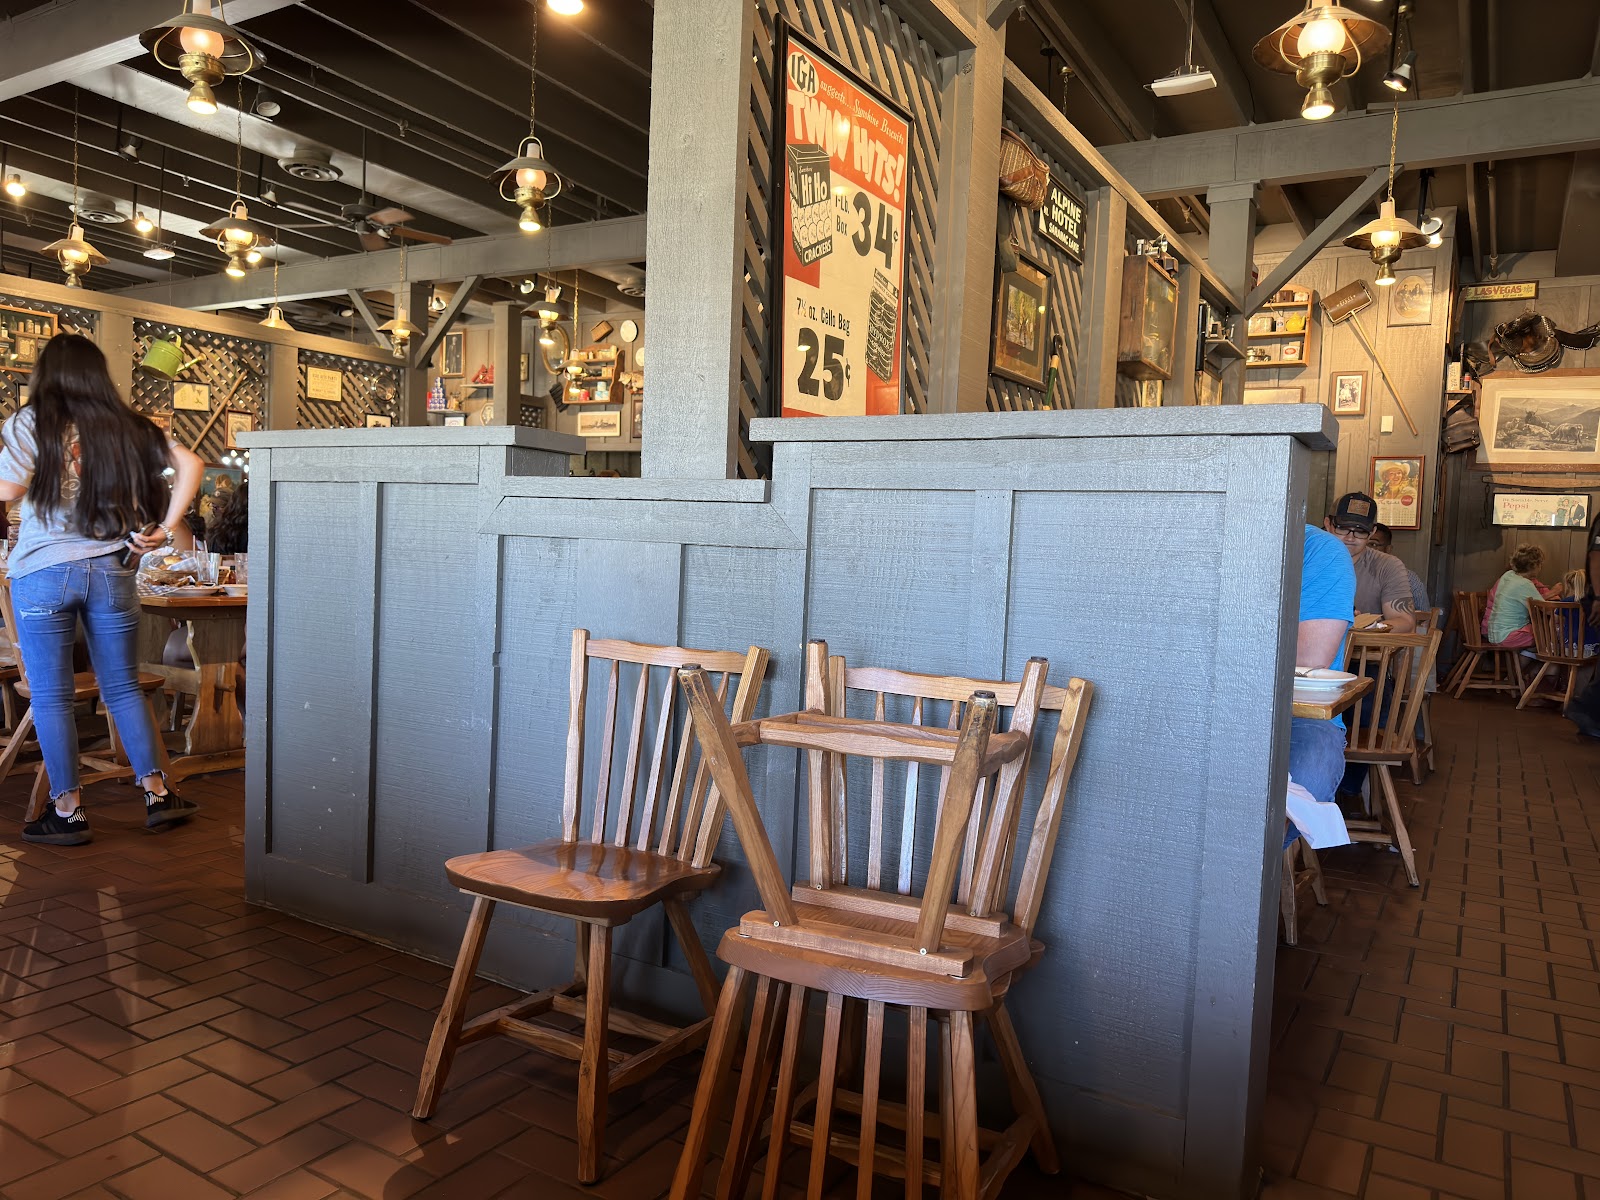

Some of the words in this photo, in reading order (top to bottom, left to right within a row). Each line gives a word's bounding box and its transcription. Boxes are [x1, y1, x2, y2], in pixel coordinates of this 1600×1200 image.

[791, 54, 816, 94] IGA
[854, 99, 879, 128] Sunshine
[880, 118, 904, 145] Biscuits
[788, 89, 850, 162] TWIN
[853, 124, 905, 203] HITS!
[801, 173, 812, 206] Hi
[813, 171, 828, 203] Ho
[1051, 187, 1081, 224] ALPINE
[1052, 204, 1079, 239] HOTEL
[803, 239, 832, 263] CRACKERS
[1474, 287, 1493, 296] LAS
[1493, 284, 1522, 295] VEGAS
[838, 312, 850, 337] Bag
[1503, 502, 1529, 511] Pepsi
